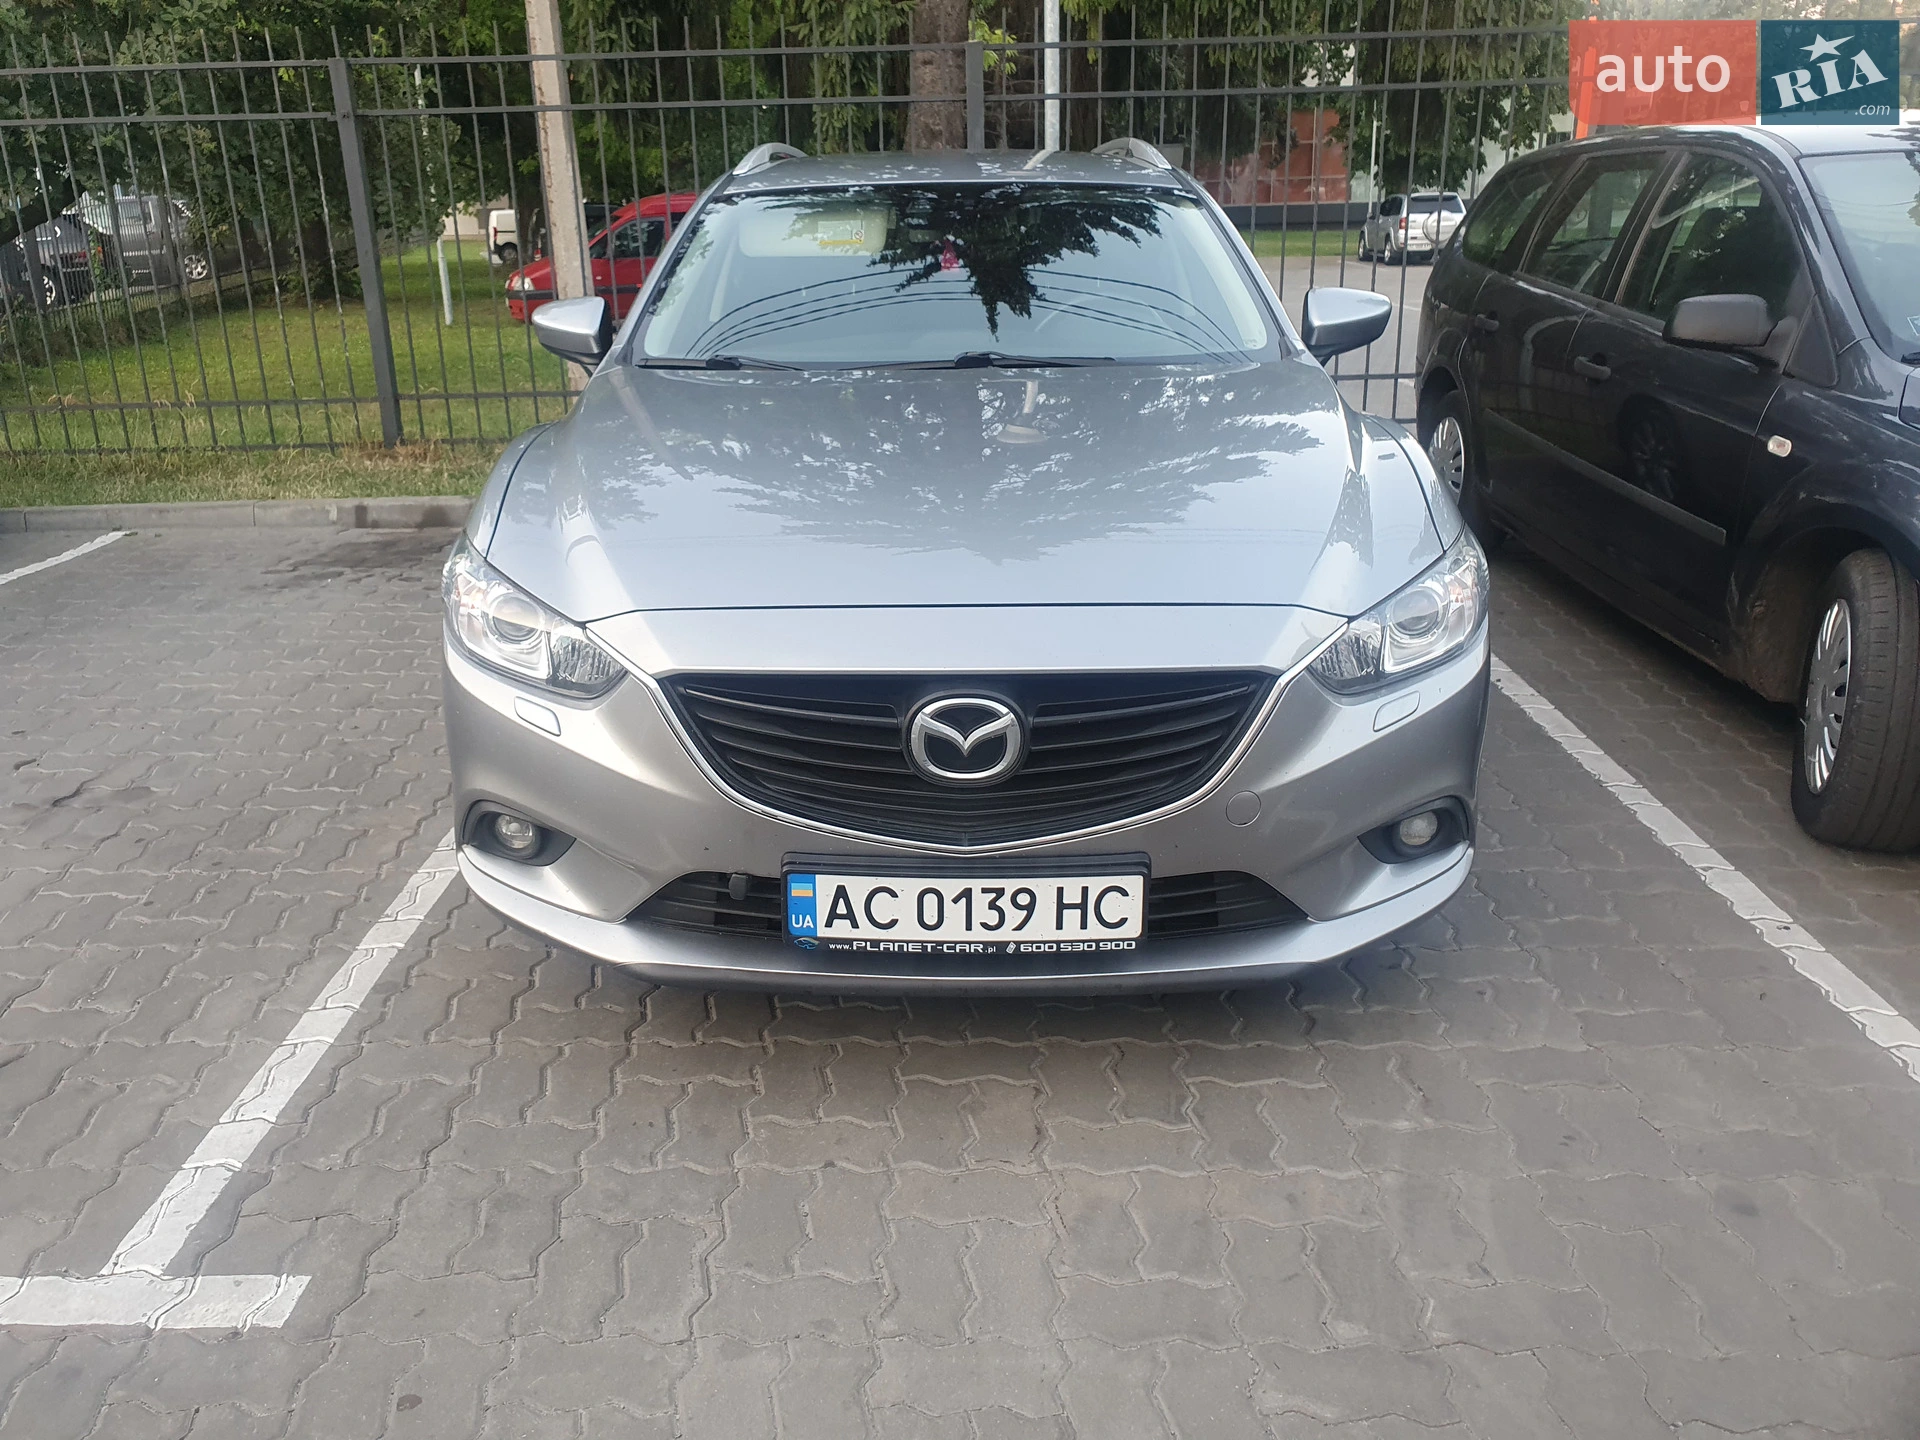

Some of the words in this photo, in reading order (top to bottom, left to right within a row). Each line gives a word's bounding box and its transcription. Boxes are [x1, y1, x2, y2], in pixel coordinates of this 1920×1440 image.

[824, 884, 899, 930] AC
[917, 886, 1037, 932] 0139
[1055, 885, 1129, 931] HC
[791, 913, 814, 929] UA
[829, 940, 996, 954] www.PLANET-CAR.pl
[1020, 942, 1057, 952] 600
[1060, 941, 1096, 951] 530
[1099, 940, 1136, 950] 900
